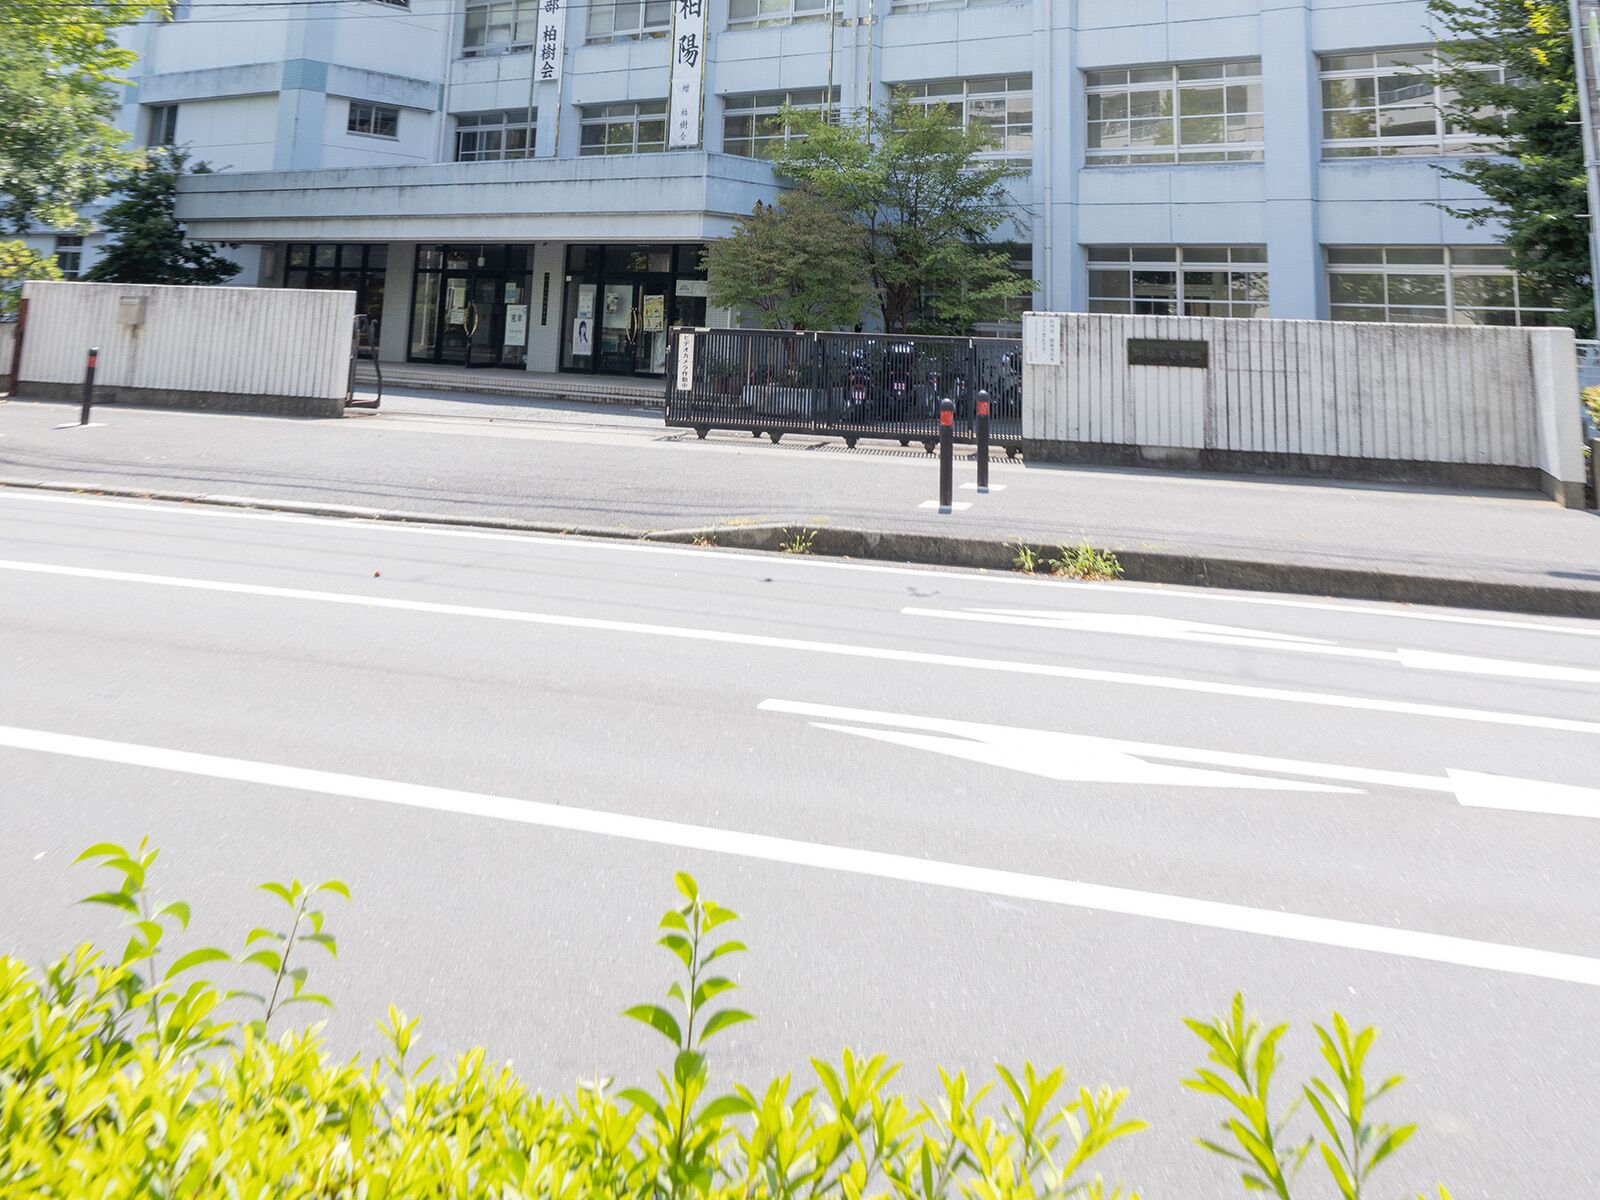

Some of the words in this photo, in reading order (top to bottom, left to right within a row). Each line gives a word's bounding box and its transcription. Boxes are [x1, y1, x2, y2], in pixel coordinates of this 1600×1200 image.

[540, 25, 557, 79] 柏樹会
[679, 108, 688, 142] 柏樹会
[681, 335, 689, 388] ビデオカメラ作動中
